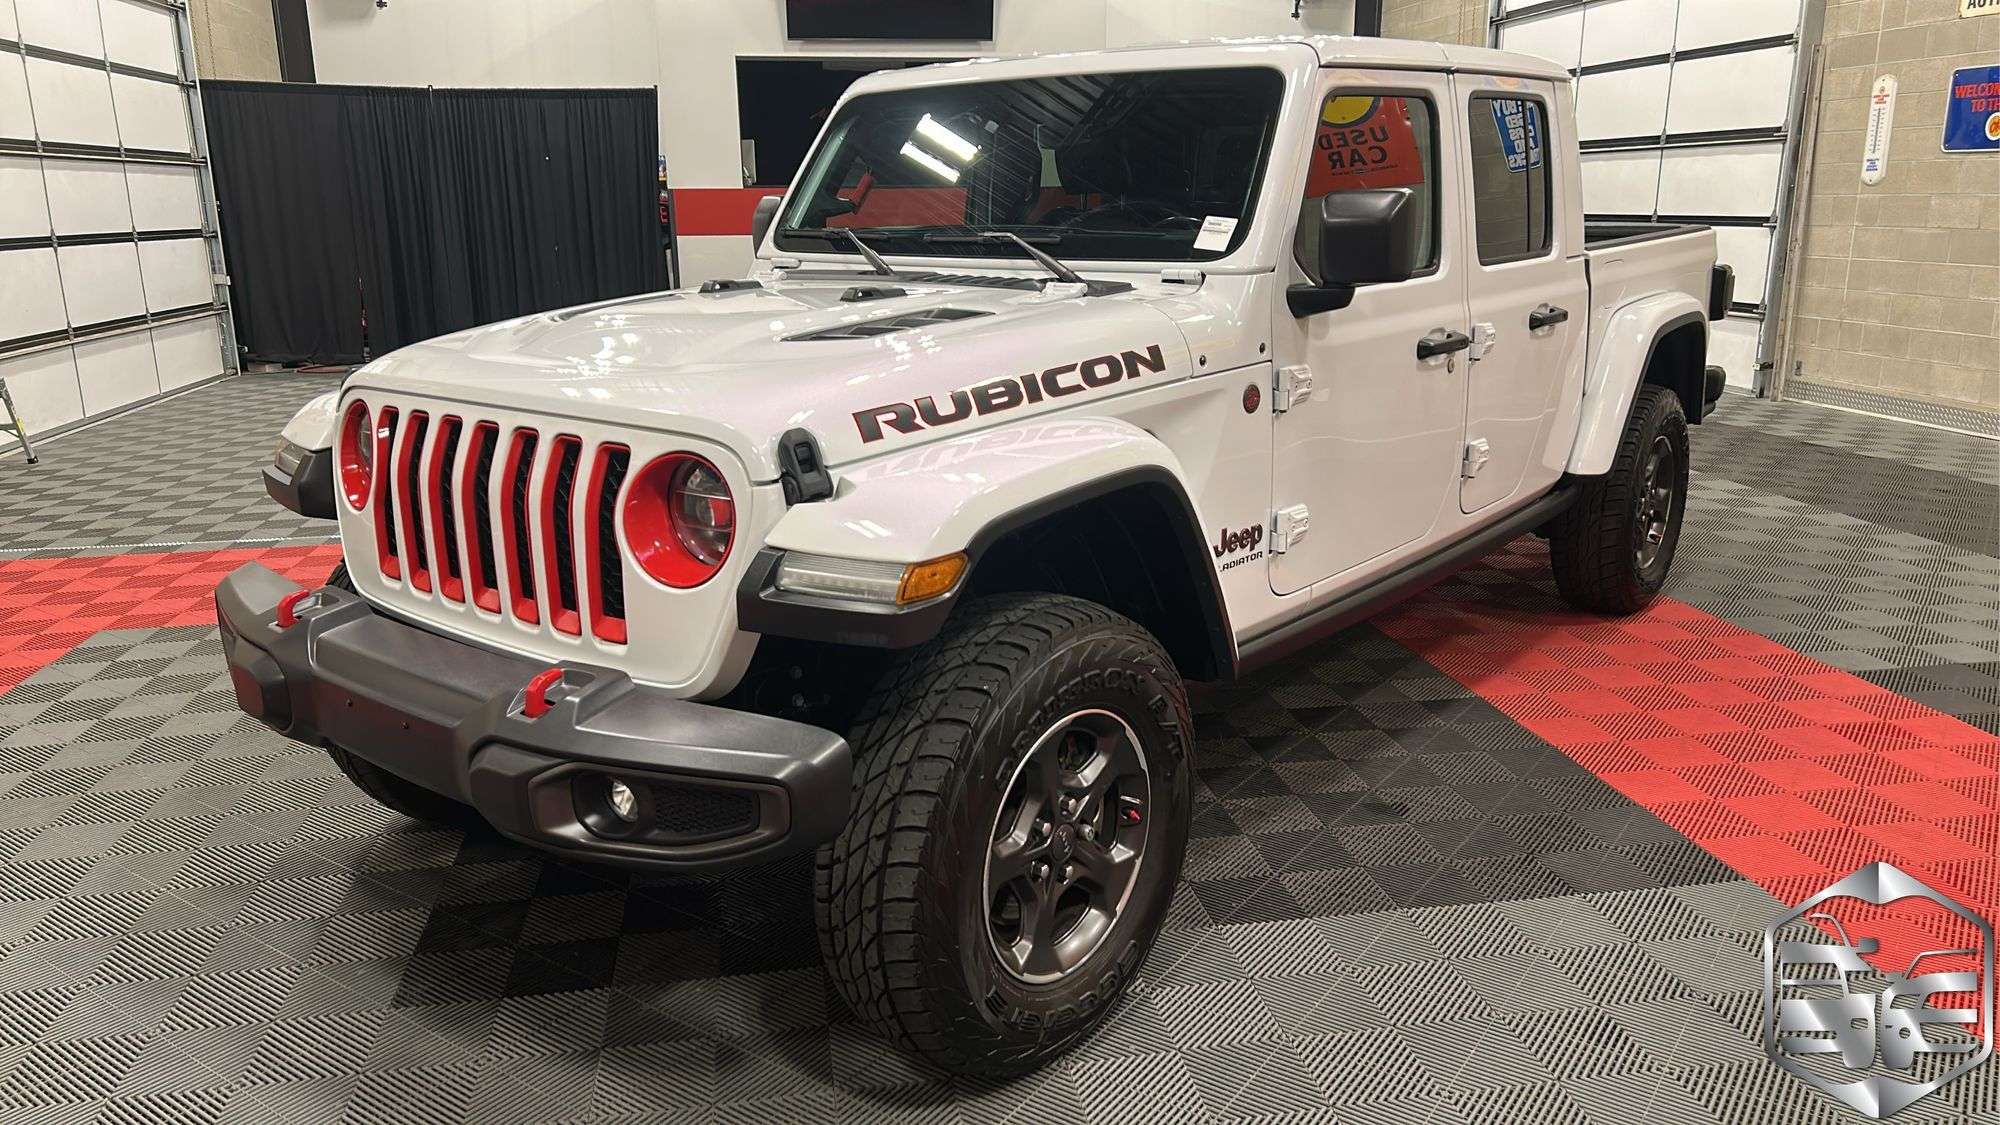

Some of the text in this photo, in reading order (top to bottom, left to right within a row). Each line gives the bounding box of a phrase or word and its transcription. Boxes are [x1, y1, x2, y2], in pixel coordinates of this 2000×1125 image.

[1971, 99, 1985, 112] TO
[852, 344, 1166, 444] RUBICON
[1213, 524, 1263, 557] Jeep
